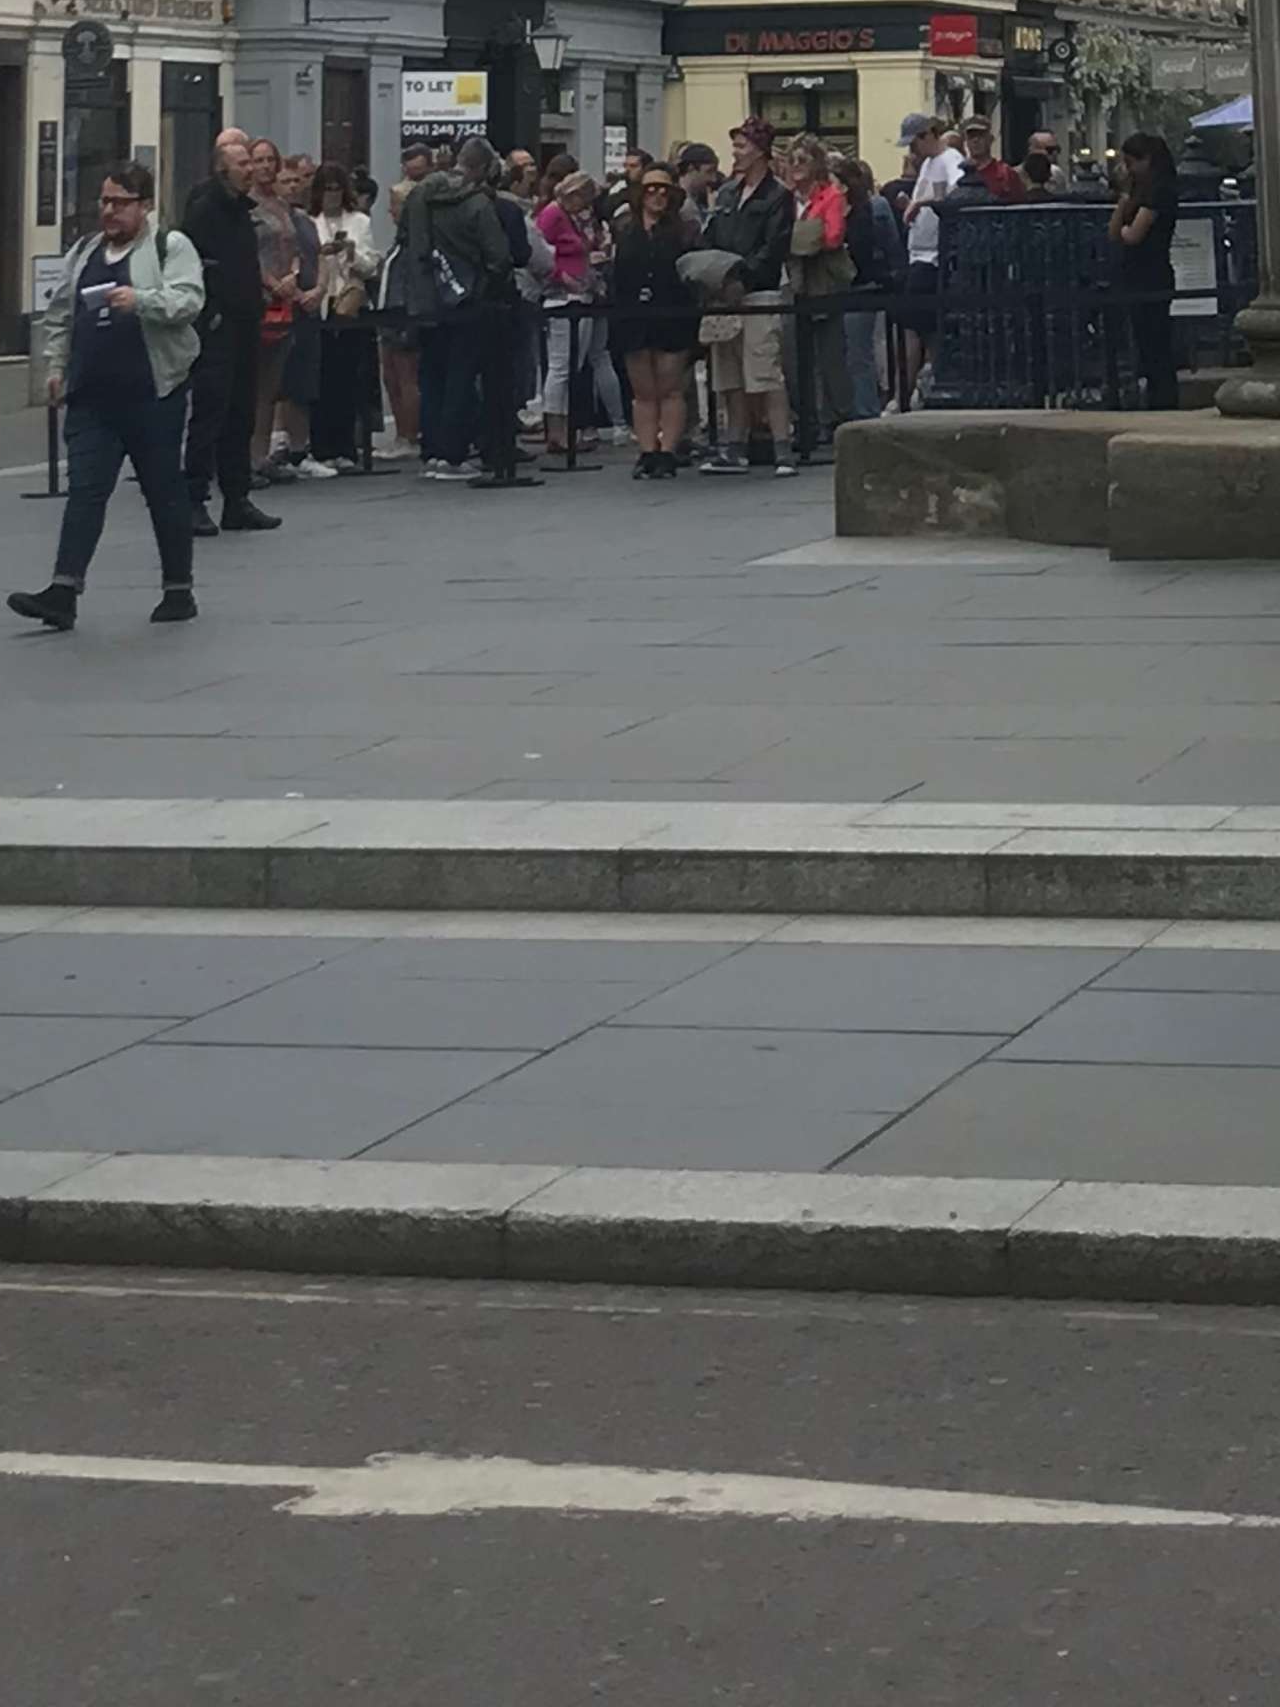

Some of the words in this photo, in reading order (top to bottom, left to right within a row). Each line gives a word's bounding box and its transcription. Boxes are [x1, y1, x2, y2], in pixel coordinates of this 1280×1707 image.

[757, 27, 875, 51] MAGGIO'S
[405, 80, 425, 93] TO
[428, 80, 454, 93] LET
